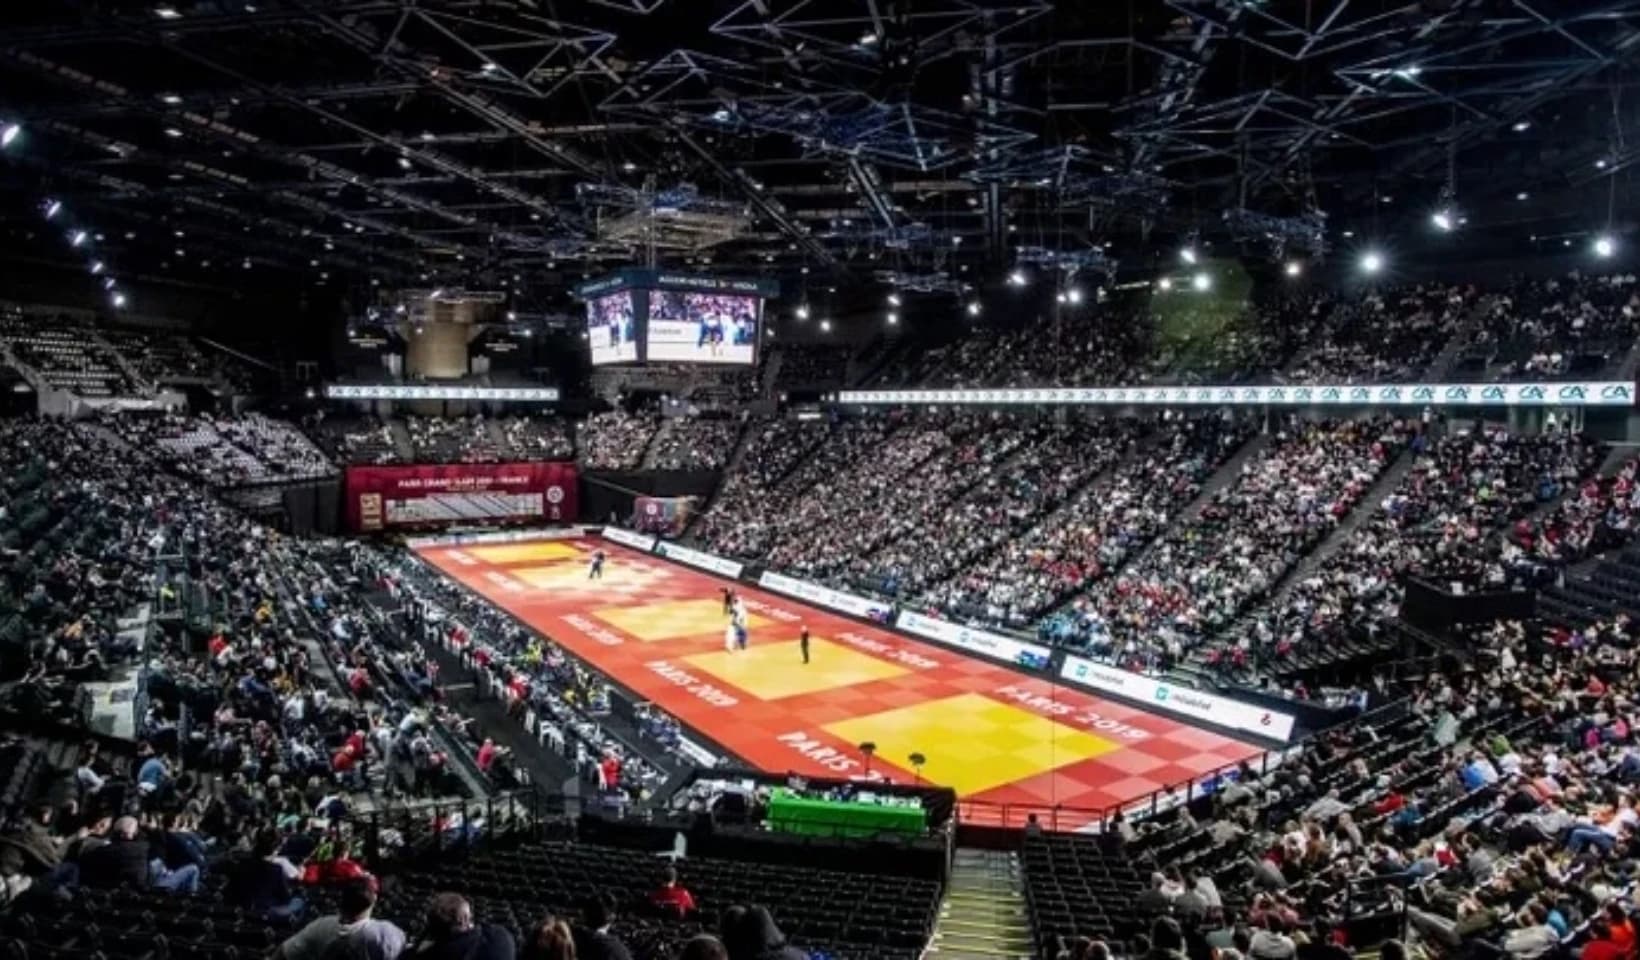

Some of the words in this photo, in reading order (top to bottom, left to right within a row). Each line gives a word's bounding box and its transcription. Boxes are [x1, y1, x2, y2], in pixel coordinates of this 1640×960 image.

[1446, 386, 1470, 399] CA
[1481, 386, 1506, 399] CA
[1519, 386, 1545, 399] CA
[1559, 386, 1588, 399] CA
[1601, 386, 1632, 399] CA
[834, 632, 893, 653] PARIS
[884, 650, 940, 669] 2019
[643, 660, 700, 686] PARIS
[686, 684, 739, 706] 2019
[994, 685, 1076, 715] PARIS
[1074, 712, 1150, 739] 2019
[776, 731, 860, 771] PARIS
